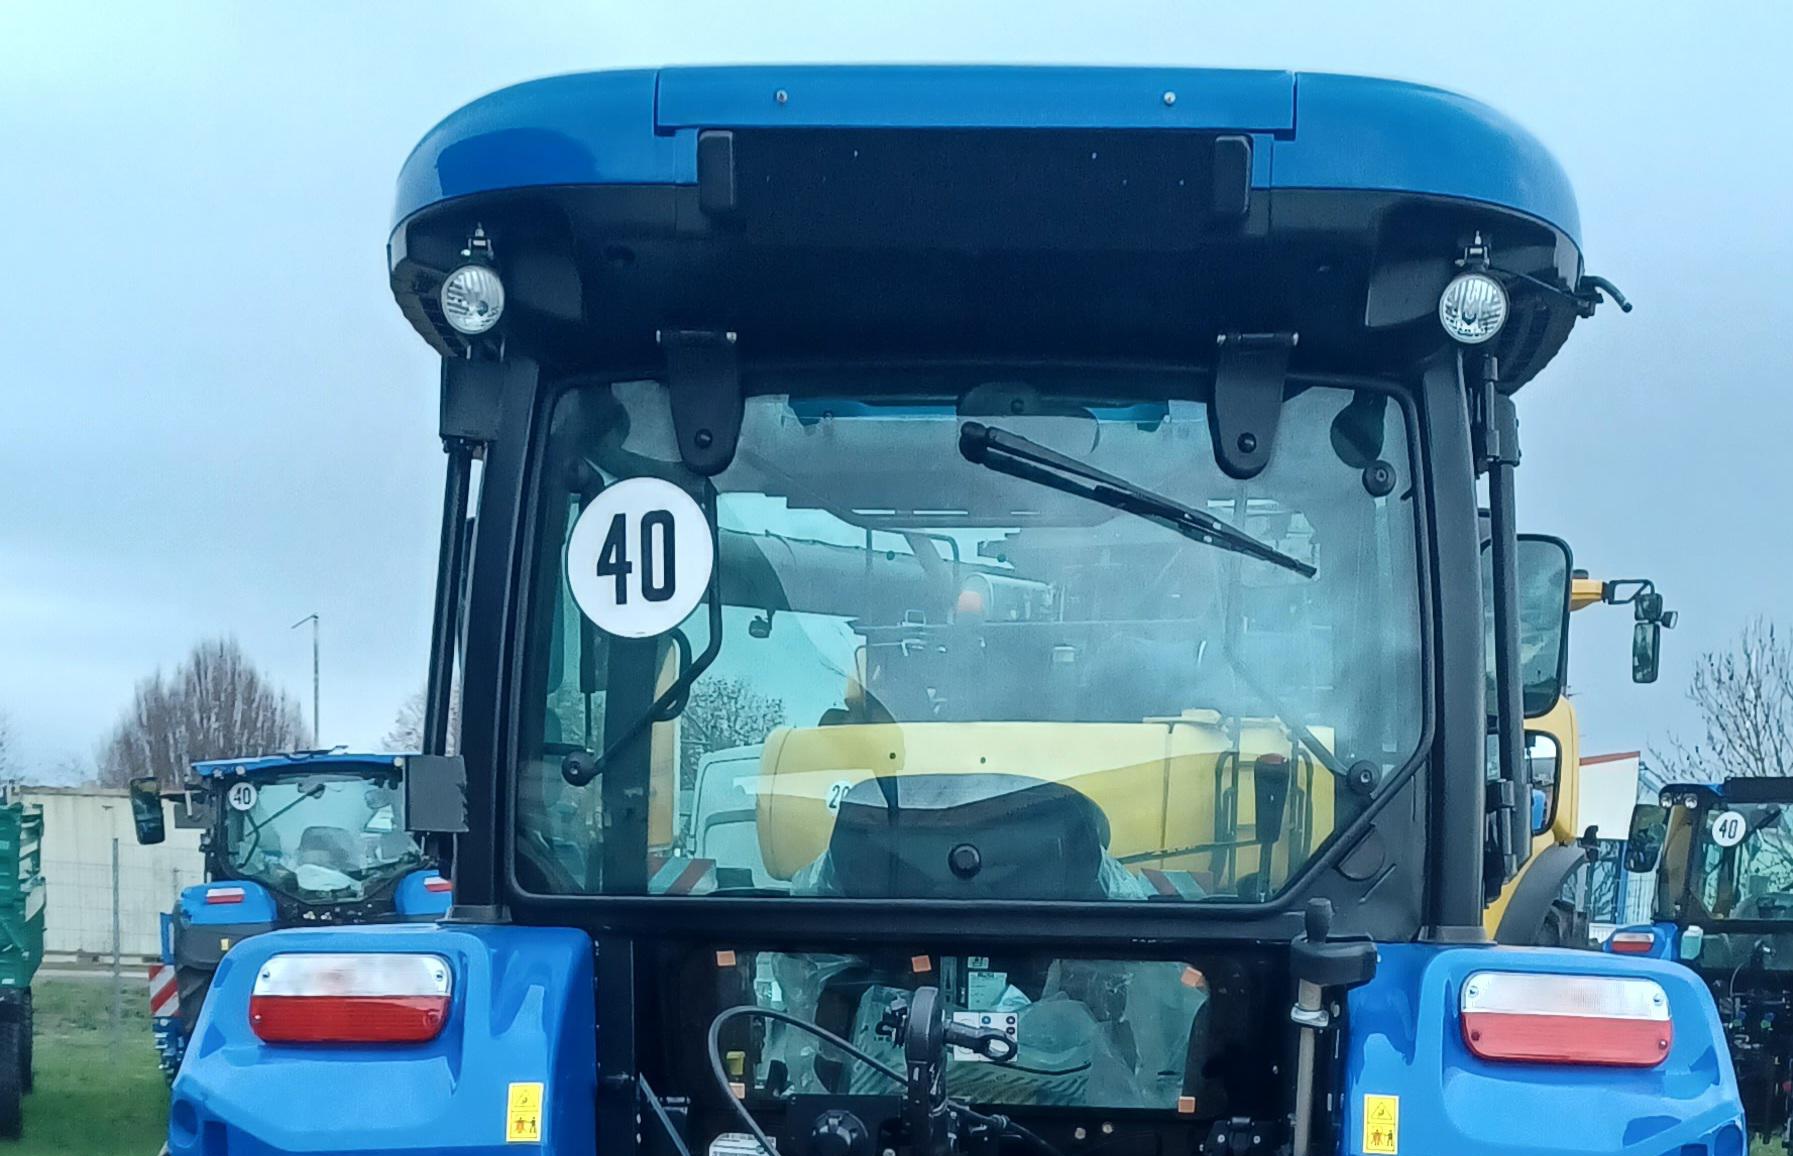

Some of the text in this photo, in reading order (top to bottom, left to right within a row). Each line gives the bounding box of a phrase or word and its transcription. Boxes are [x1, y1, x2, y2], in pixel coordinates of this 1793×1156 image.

[597, 510, 675, 605] 40
[234, 787, 251, 804] 40
[1719, 819, 1738, 839] 40
